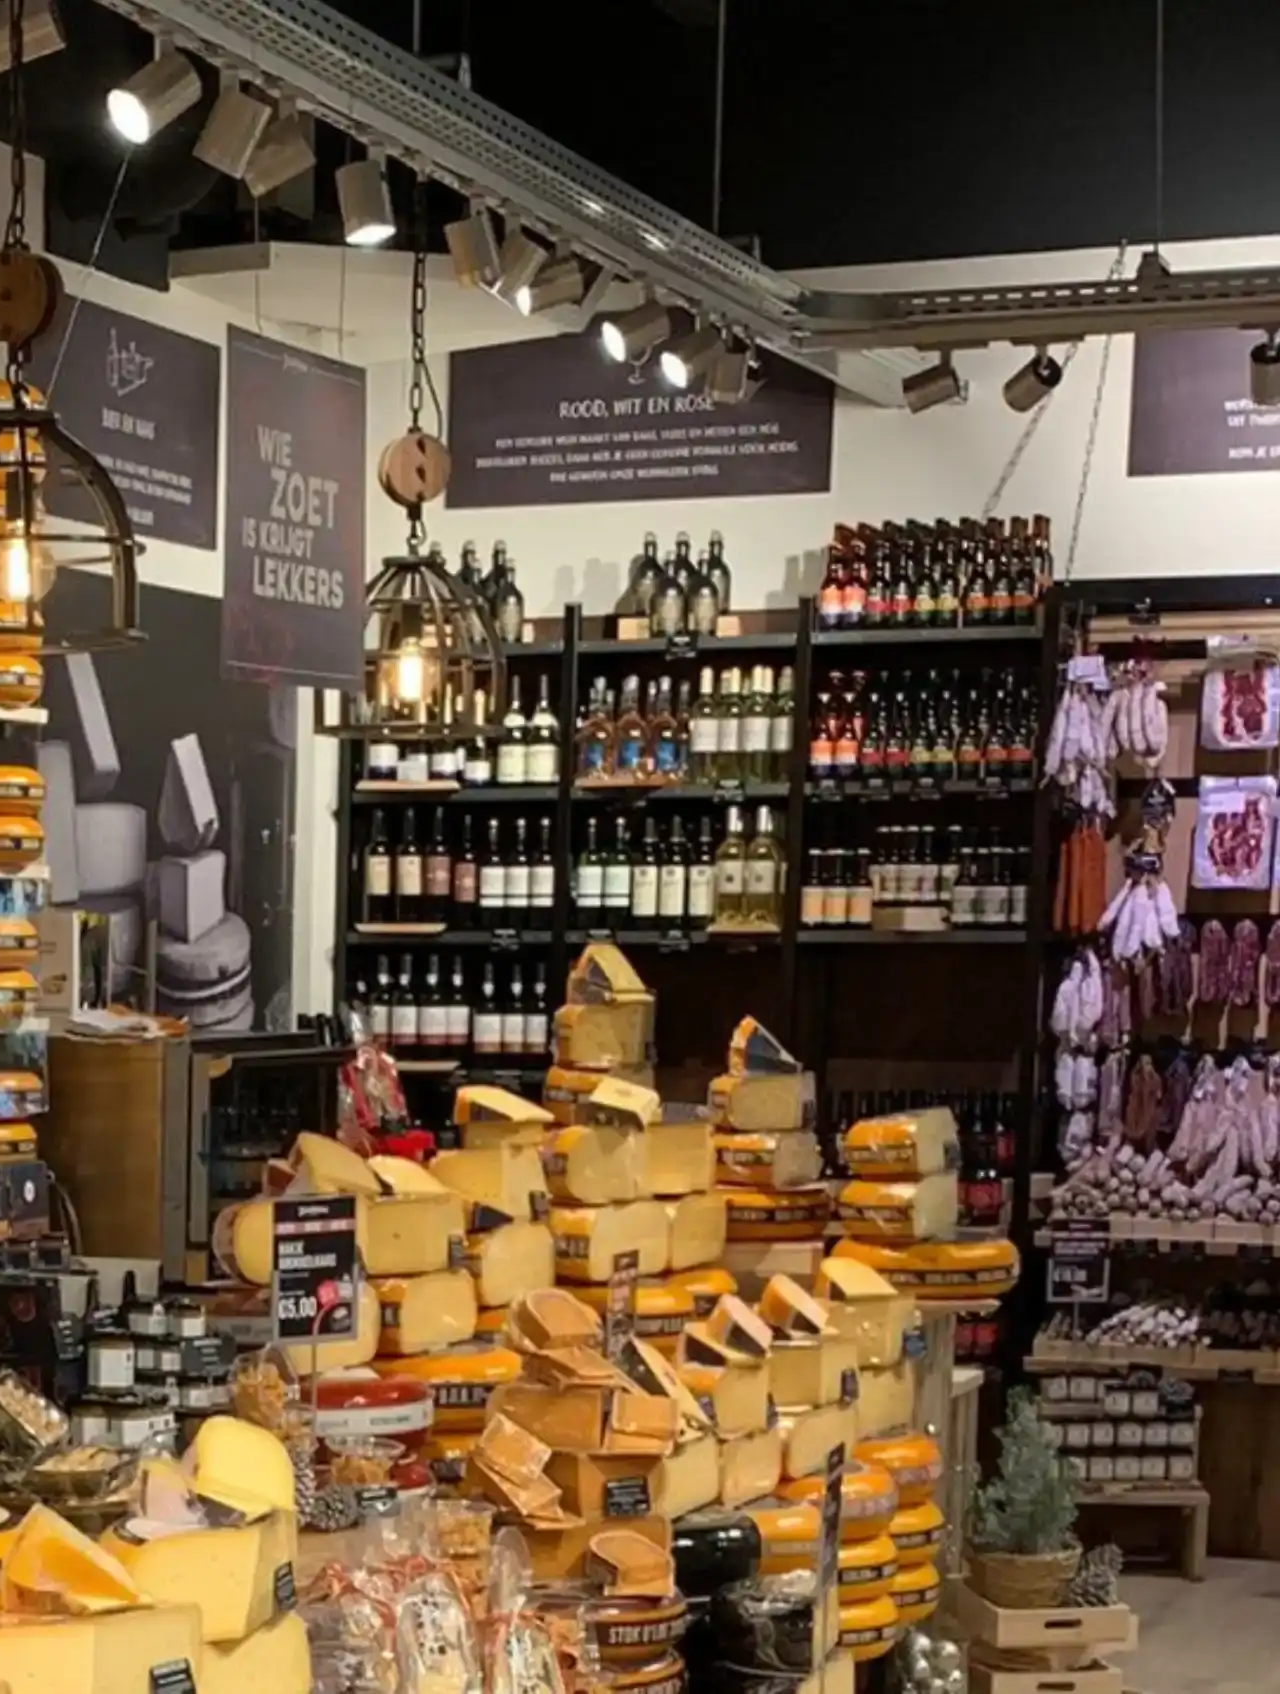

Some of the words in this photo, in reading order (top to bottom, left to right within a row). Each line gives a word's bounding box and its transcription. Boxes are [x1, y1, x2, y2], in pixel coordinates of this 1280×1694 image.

[559, 399, 609, 420] ROOD,
[614, 398, 643, 416] WIT
[648, 396, 670, 414] EN
[256, 425, 292, 466] WIE
[270, 469, 339, 529] ZOET
[242, 519, 257, 549] IS
[259, 522, 316, 562] KRIJGT
[252, 555, 344, 610] LEKKERS
